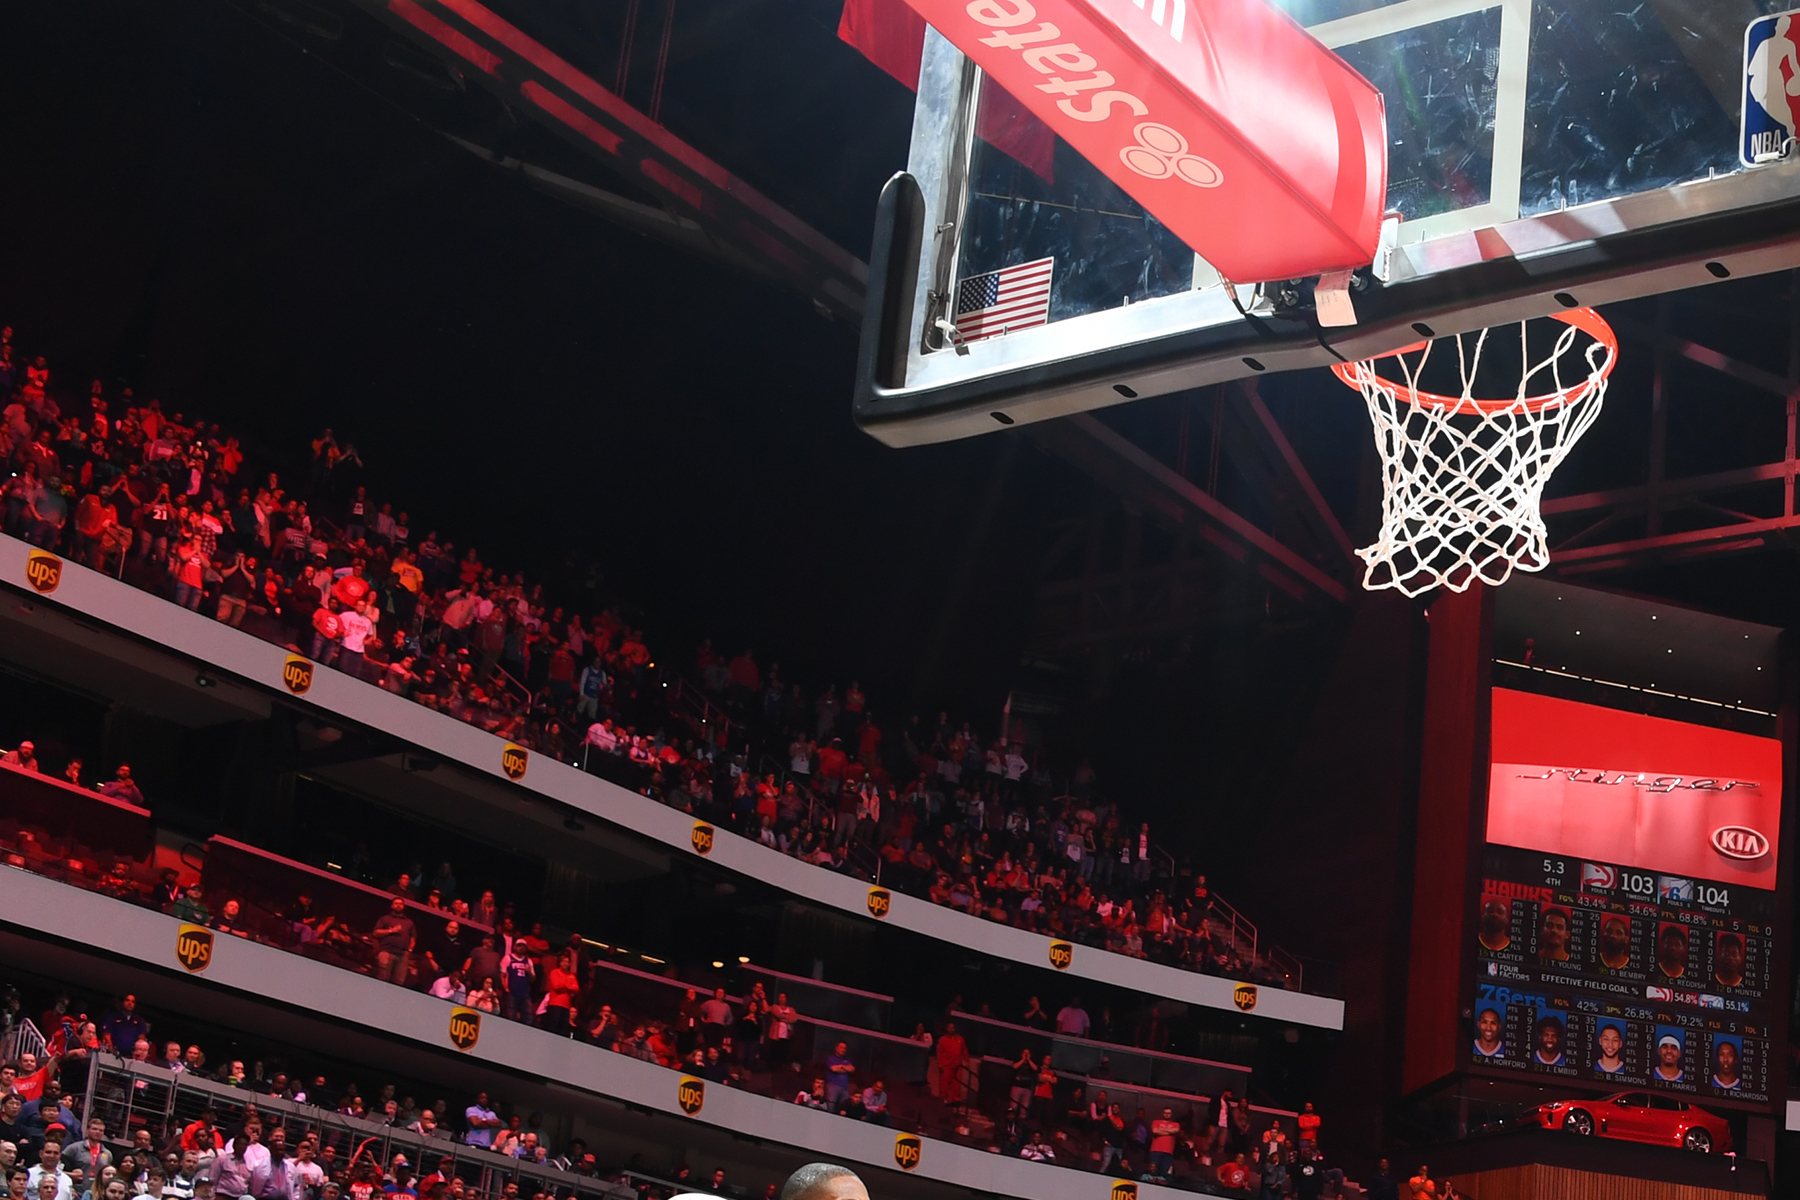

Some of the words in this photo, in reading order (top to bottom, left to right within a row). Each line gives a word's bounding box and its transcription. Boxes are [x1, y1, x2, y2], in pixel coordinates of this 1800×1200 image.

[1751, 129, 1782, 157] NBA
[29, 560, 58, 586] ups
[285, 662, 310, 688] ups
[503, 752, 527, 775] ups
[693, 832, 711, 850] ups
[1721, 831, 1759, 853] KIA
[1543, 860, 1565, 874] 5.3
[1545, 877, 1561, 887] 4TH
[1621, 873, 1654, 895] 103
[870, 894, 888, 912] ups
[1697, 886, 1729, 907] 104
[1484, 879, 1553, 904] HAWKS
[1559, 894, 1574, 903] FG%
[1577, 896, 1606, 909] 43.4%
[1629, 905, 1657, 917] 34.6%
[1661, 911, 1675, 919] FT%
[1679, 913, 1707, 926] 68.8%
[1733, 921, 1739, 931] 5
[1748, 925, 1760, 933] TOL
[1765, 926, 1772, 936] 0
[178, 936, 209, 964] ups
[1051, 944, 1069, 964] ups
[1497, 952, 1524, 962] CARTER
[1500, 964, 1518, 973] FOUR
[1558, 961, 1582, 971] YOUNG
[1619, 970, 1646, 980] BEMBRY
[1499, 970, 1530, 981] FACTORS
[1677, 978, 1706, 989] REDDISH
[1235, 991, 1255, 1010] ups
[1541, 974, 1582, 987] EFFECTIVE
[1584, 980, 1607, 990] FIELD
[1609, 984, 1630, 994] GOAL
[1631, 987, 1639, 995] %
[1674, 992, 1697, 1004] 54.8%
[1726, 1000, 1749, 1012] 55.1%
[1735, 987, 1762, 998] HUNTER
[1480, 984, 1546, 1009] 76ers
[1554, 999, 1569, 1007] FG%
[1576, 1001, 1599, 1012] 42%
[1606, 1006, 1621, 1014] 3P%
[1624, 1008, 1653, 1020] 26.8%
[1657, 1013, 1671, 1021] FT%
[1676, 1015, 1703, 1027] 79.2%
[1709, 1021, 1721, 1029] FLS
[1730, 1023, 1736, 1032] 5
[1744, 1026, 1756, 1034] TOL
[451, 1018, 478, 1044] ups
[1493, 1057, 1526, 1069] HORFORD
[1553, 1067, 1578, 1076] EMBIID
[1615, 1075, 1647, 1085] SIMMONS
[1672, 1083, 1697, 1092] HARRIS
[680, 1085, 701, 1109] ups
[1730, 1090, 1768, 1101] RICHARDSON
[896, 1142, 918, 1164] ups
